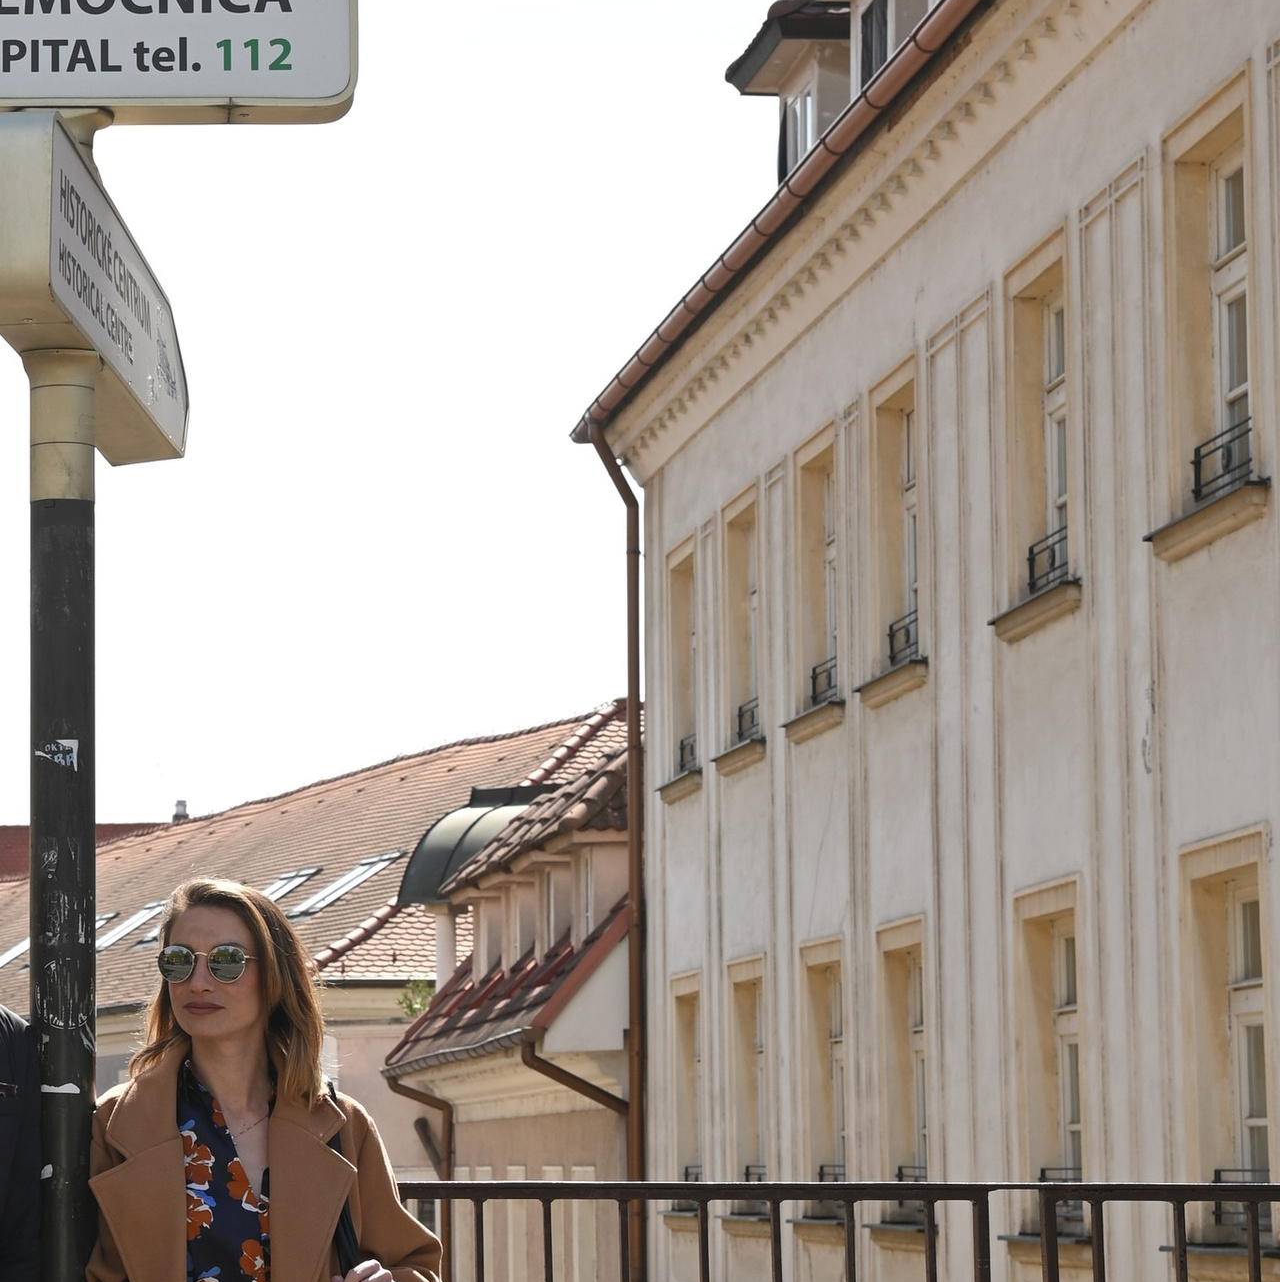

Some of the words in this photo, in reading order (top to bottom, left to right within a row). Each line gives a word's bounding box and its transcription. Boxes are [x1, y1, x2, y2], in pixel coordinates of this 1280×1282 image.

[132, 36, 202, 73] tel.
[216, 37, 293, 72] 112
[58, 238, 105, 330] HISTORICAL
[106, 303, 133, 366] CENTRE
[59, 169, 113, 283] HISTORICKÉ
[113, 251, 152, 340] CENTRUM
